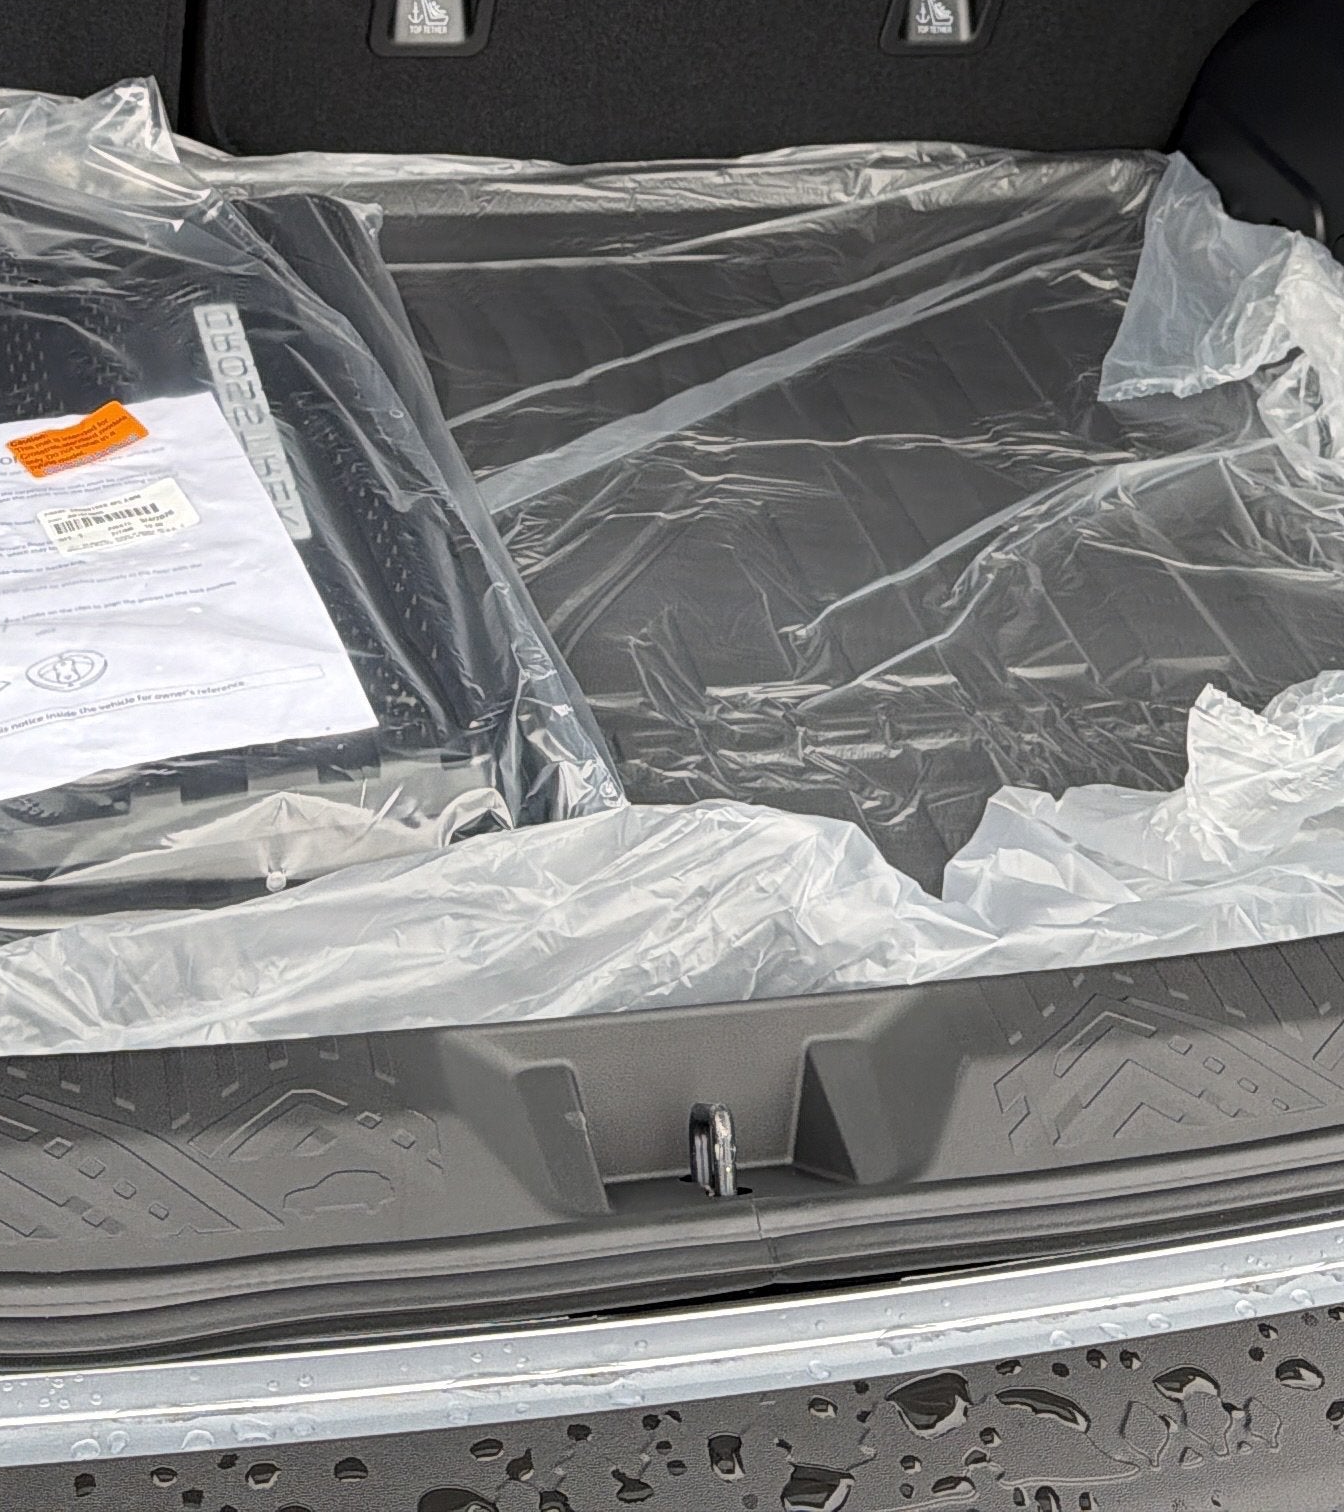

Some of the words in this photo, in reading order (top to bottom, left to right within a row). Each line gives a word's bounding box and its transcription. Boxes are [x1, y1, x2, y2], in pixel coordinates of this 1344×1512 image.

[10, 715, 44, 731] notice
[46, 708, 77, 720] inside
[78, 703, 97, 715] the
[99, 695, 135, 711] vehicle
[136, 694, 153, 703] for
[154, 689, 196, 701] owner's
[197, 680, 245, 696] reference
